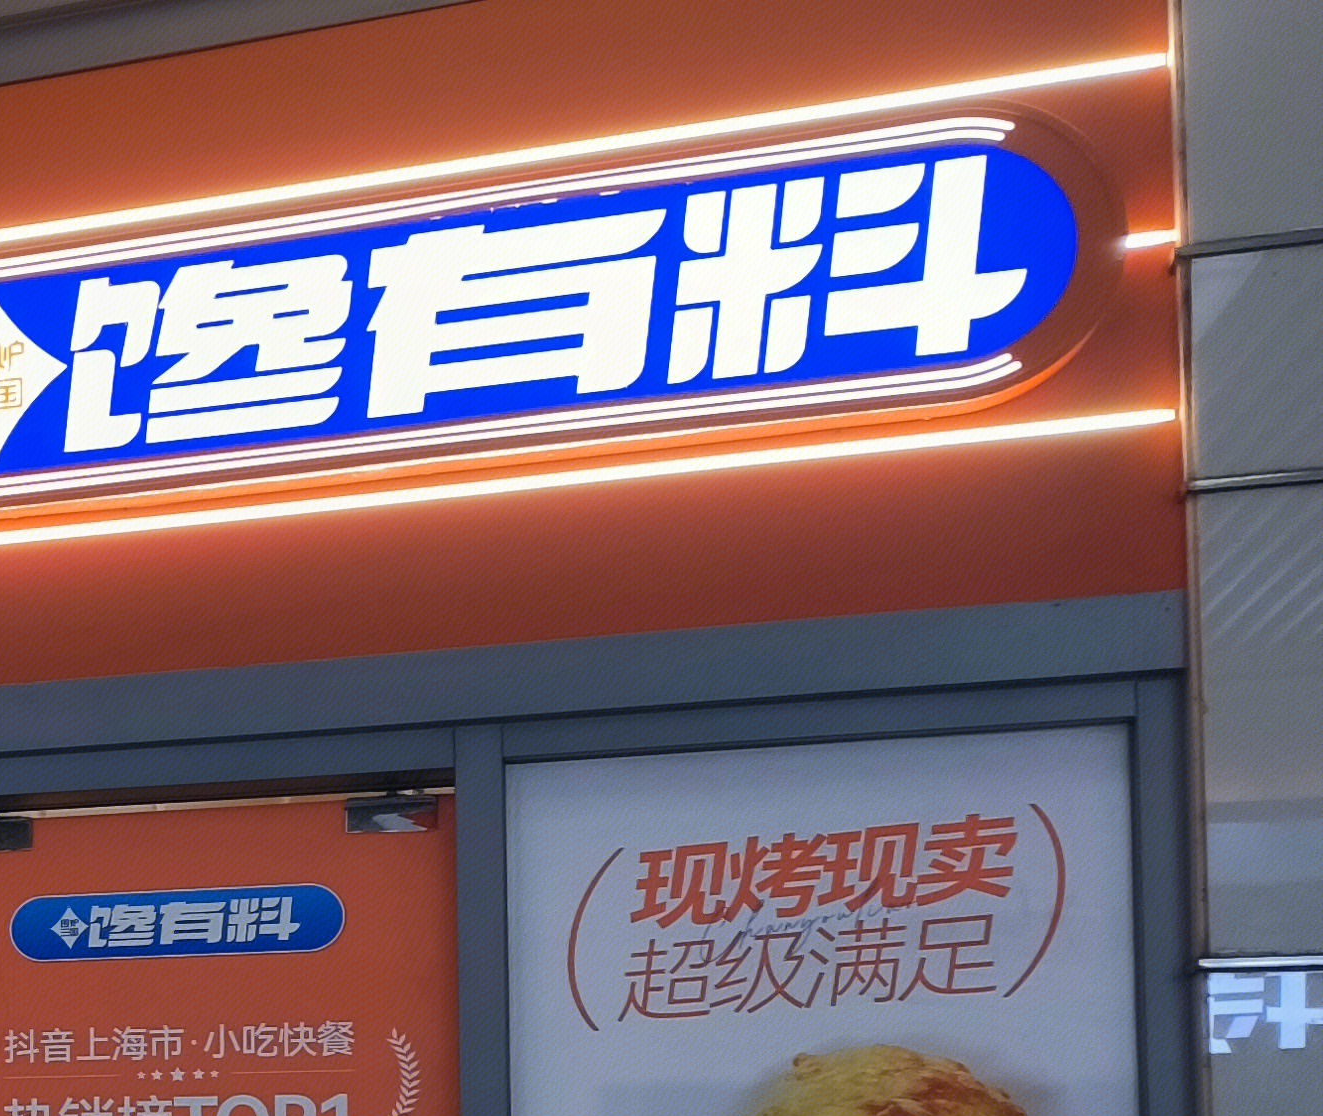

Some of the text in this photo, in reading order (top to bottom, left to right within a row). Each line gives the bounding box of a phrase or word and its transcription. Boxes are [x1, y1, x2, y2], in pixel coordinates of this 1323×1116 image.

[63, 152, 1027, 454] 馋有料
[88, 896, 301, 948] 馋有料
[630, 813, 1017, 928] 现烤现卖
[617, 913, 998, 1020] 超级满足
